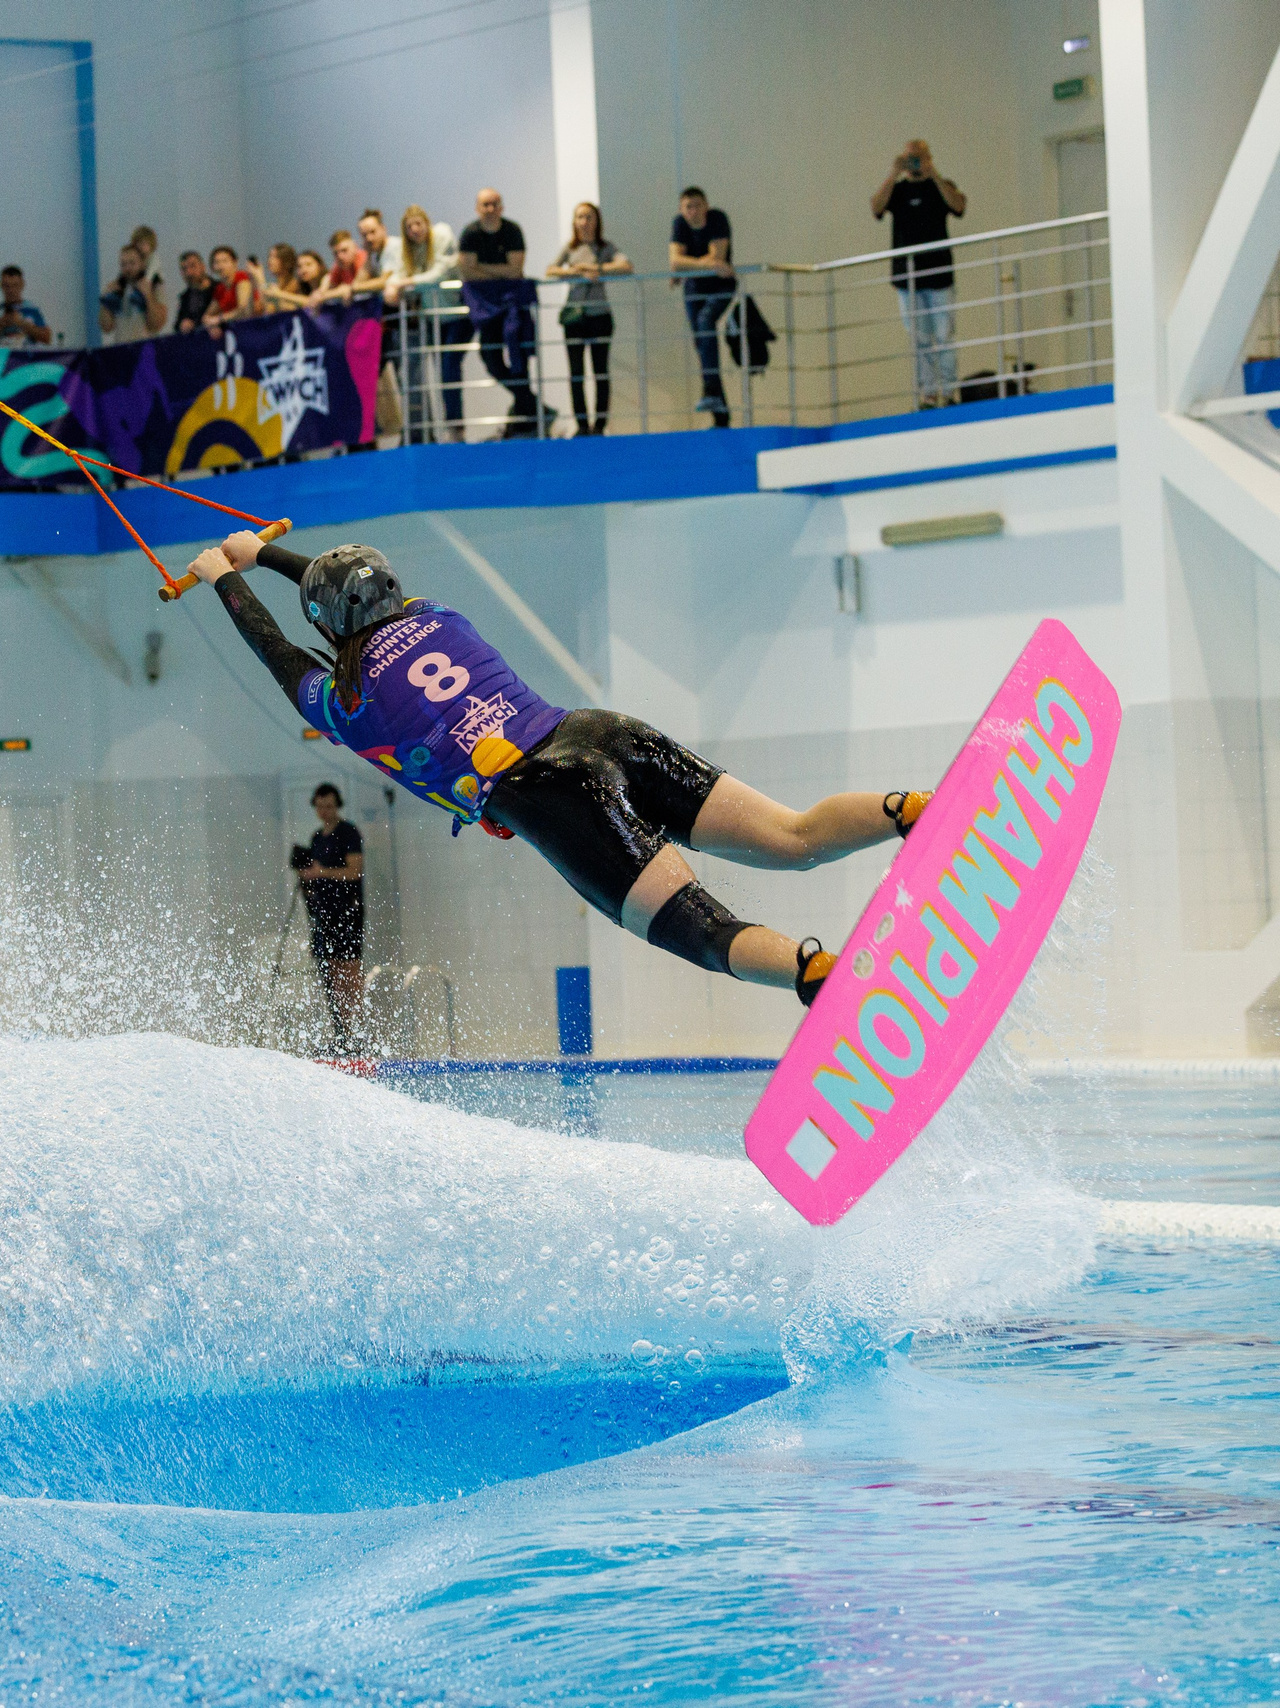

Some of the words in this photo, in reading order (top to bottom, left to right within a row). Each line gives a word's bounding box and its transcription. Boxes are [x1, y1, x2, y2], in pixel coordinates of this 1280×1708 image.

[368, 620, 442, 678] CHALLENGE
[369, 621, 421, 660] WINTER
[407, 652, 470, 702] 8
[458, 703, 515, 754] KWWCH
